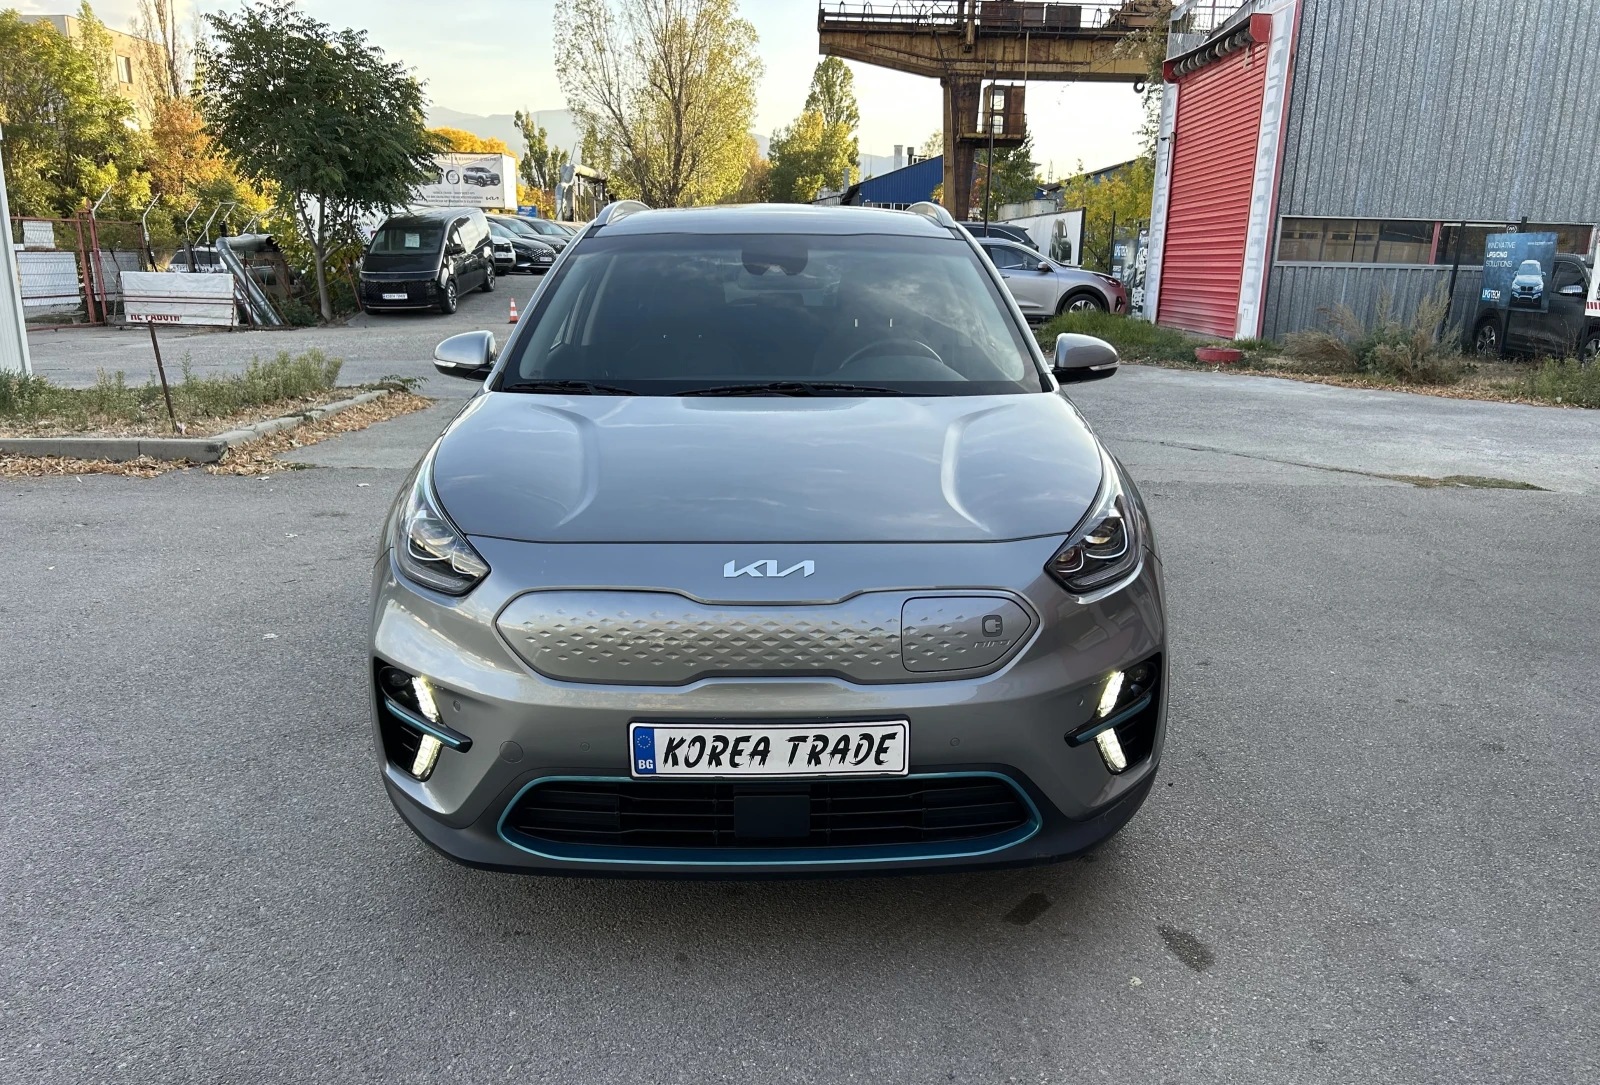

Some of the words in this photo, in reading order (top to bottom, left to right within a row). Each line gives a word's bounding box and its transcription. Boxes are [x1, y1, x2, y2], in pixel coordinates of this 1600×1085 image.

[1487, 241, 1516, 249] INNOVATIVE
[1485, 260, 1513, 268] SOLUTIONS
[723, 559, 815, 578] KIA
[662, 734, 771, 769] KOREA
[786, 731, 899, 768] TRADE
[638, 759, 654, 769] BG
